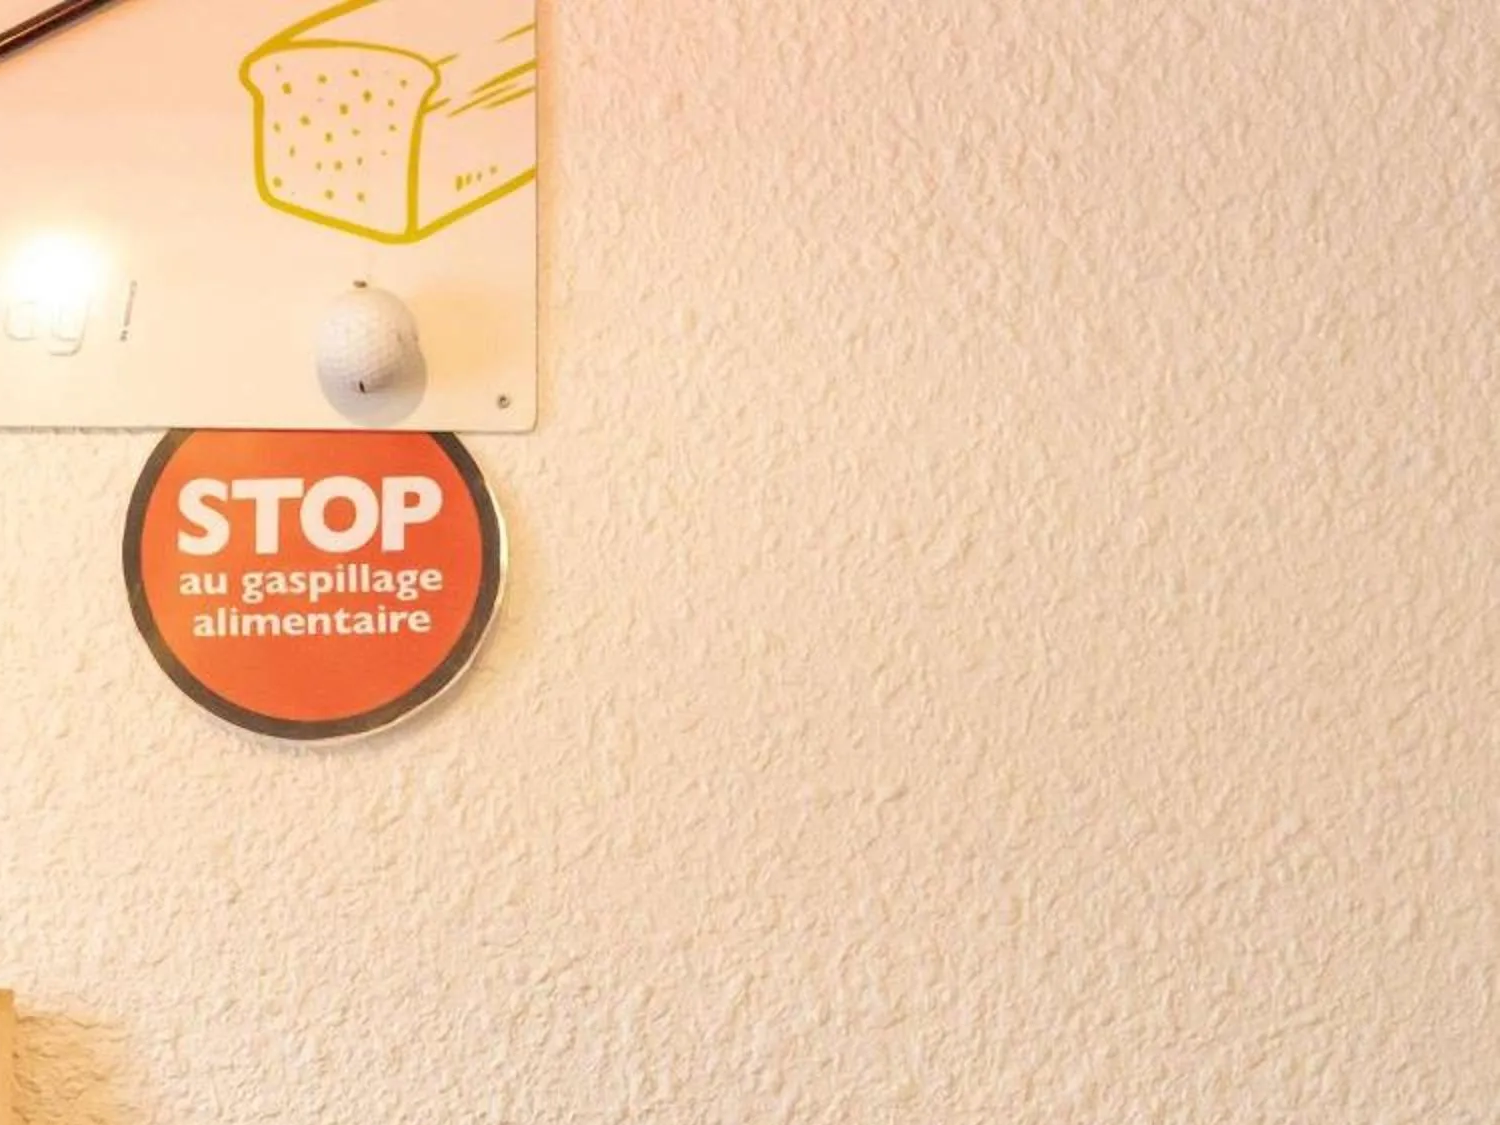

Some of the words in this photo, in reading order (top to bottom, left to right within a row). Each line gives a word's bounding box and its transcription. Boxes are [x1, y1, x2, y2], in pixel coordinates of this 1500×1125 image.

[177, 476, 443, 555] STOP
[179, 571, 228, 596] au
[242, 563, 443, 602] gaspillage
[193, 605, 432, 638] alimentaire
